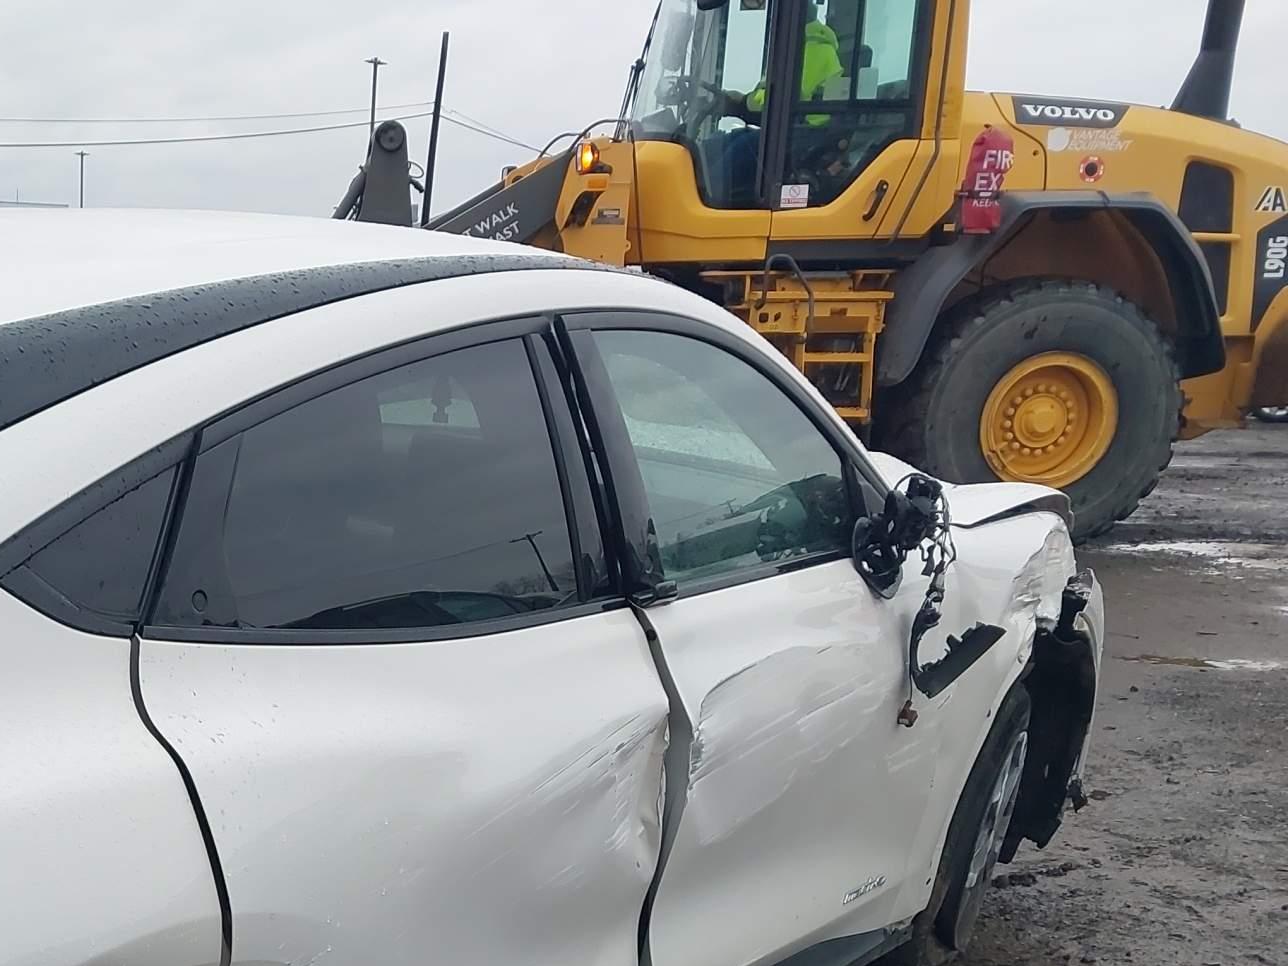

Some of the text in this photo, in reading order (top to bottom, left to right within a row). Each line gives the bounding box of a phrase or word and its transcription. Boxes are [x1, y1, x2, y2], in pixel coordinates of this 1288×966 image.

[1022, 103, 1115, 121] VOLVO
[474, 202, 519, 234] WALK
[488, 220, 520, 241] AST
[1263, 235, 1288, 279] L90G
